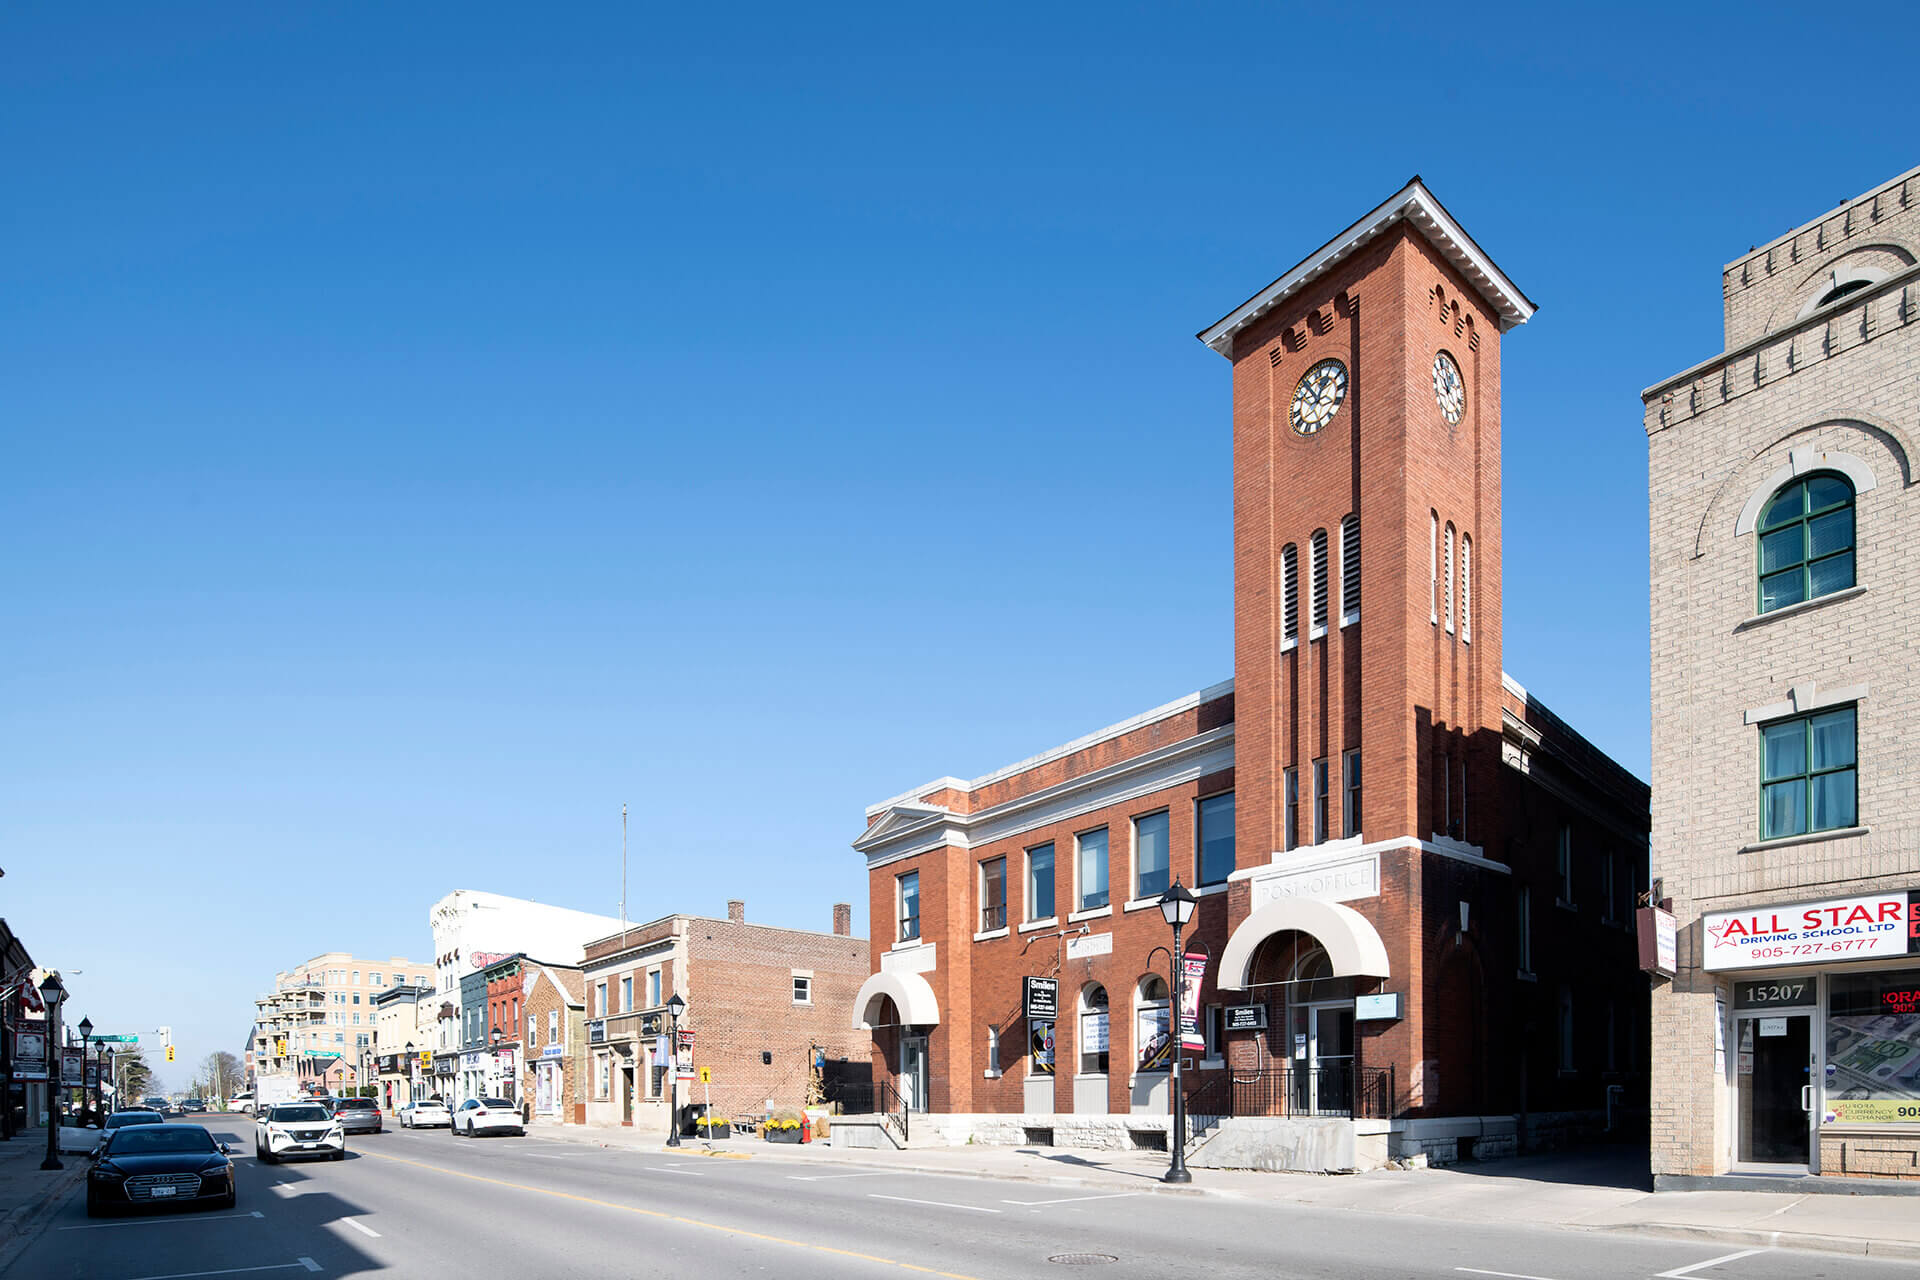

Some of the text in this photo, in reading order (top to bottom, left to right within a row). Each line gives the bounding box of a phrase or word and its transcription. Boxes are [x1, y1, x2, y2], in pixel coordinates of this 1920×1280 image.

[1262, 868, 1369, 900] POST OFFICE
[1723, 914, 1789, 938] ALL
[1803, 901, 1902, 929] STAR
[1740, 923, 1895, 945] DRIVING SCHOOL LTD
[1751, 938, 1878, 959] 905-727-6777
[1030, 979, 1055, 990] Smiles
[1746, 984, 1804, 1002] 15207
[1897, 1106, 1920, 1117] 90
